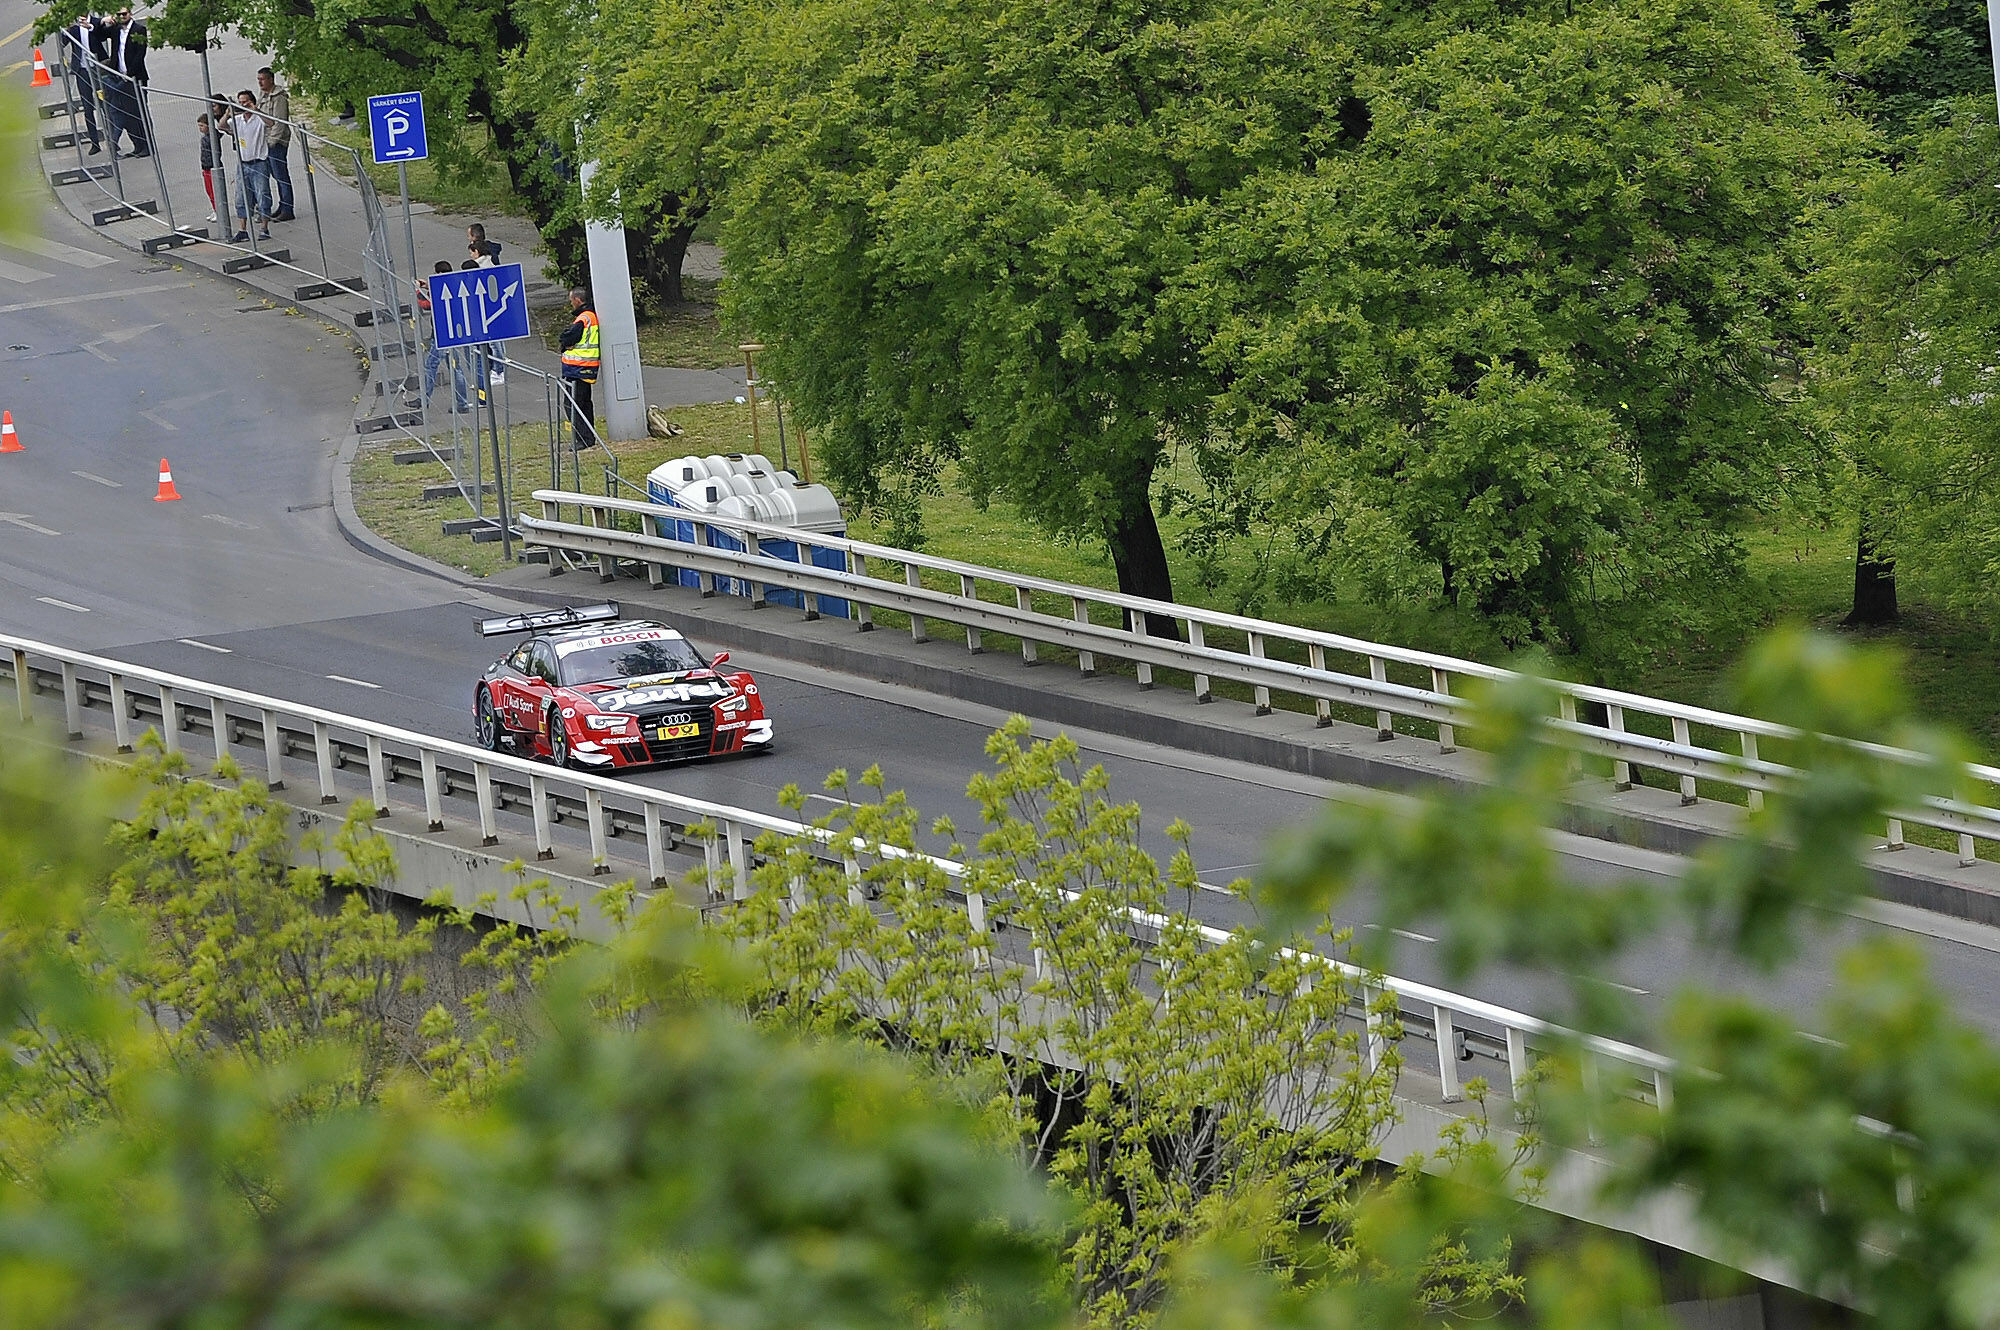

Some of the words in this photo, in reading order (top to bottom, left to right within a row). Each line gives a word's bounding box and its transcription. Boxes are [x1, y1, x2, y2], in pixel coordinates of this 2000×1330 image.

[387, 117, 409, 146] P
[600, 632, 661, 645] BOSCH
[508, 694, 520, 710] Audi
[519, 698, 534, 714] Sport
[597, 681, 728, 711] Teufel
